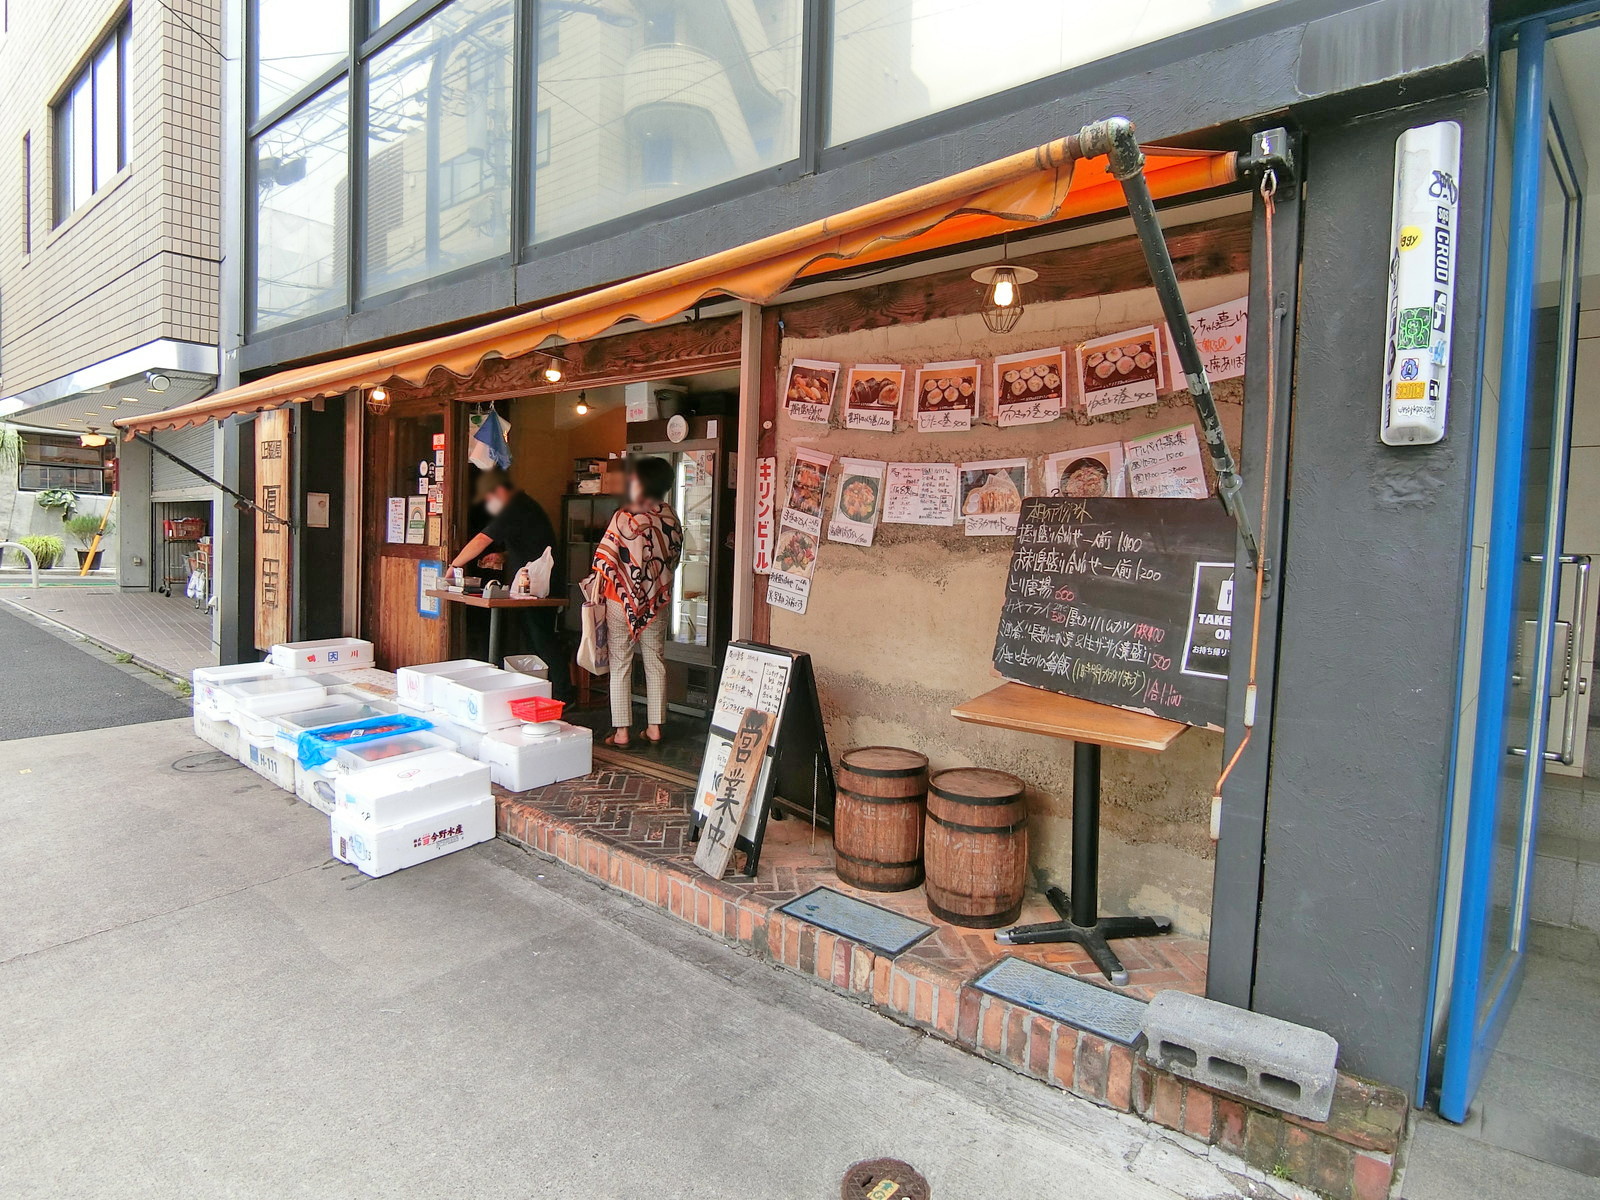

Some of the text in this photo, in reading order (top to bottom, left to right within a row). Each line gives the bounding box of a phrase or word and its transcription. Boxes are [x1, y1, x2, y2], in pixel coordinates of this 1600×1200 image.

[756, 463, 772, 570] キリンビール
[1198, 613, 1232, 627] TAKE
[1192, 645, 1230, 657] お持ち帰り
[260, 752, 278, 775] H-111
[707, 711, 768, 856] 営業中
